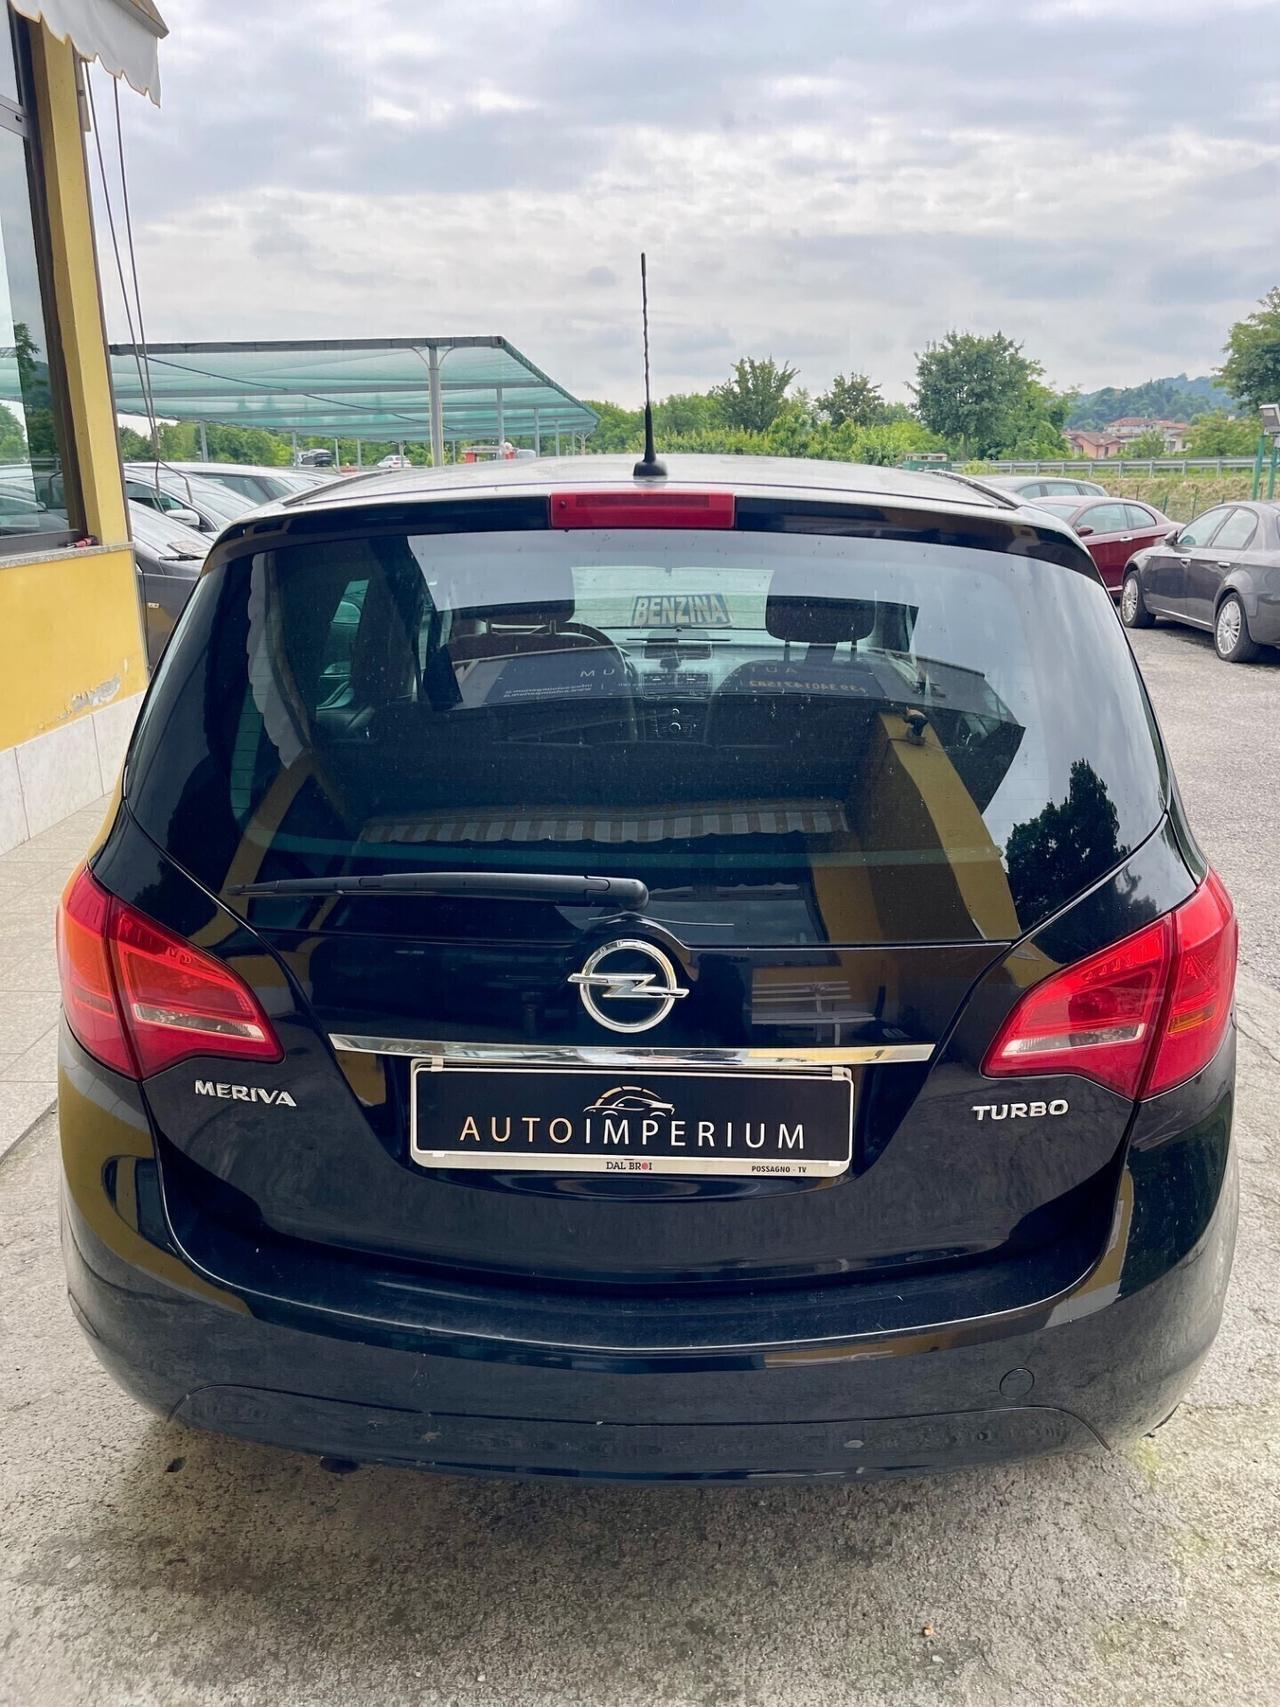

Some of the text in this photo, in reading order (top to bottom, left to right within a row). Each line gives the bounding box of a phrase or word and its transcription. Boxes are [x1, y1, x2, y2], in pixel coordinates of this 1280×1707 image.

[633, 595, 728, 624] BENZINA
[195, 1080, 297, 1107] MERIVA
[971, 1099, 1069, 1121] TURBO
[460, 1116, 805, 1150] AUTOIMPERIUM
[606, 1161, 626, 1170] DAL
[751, 1165, 791, 1173] POSSAGNO
